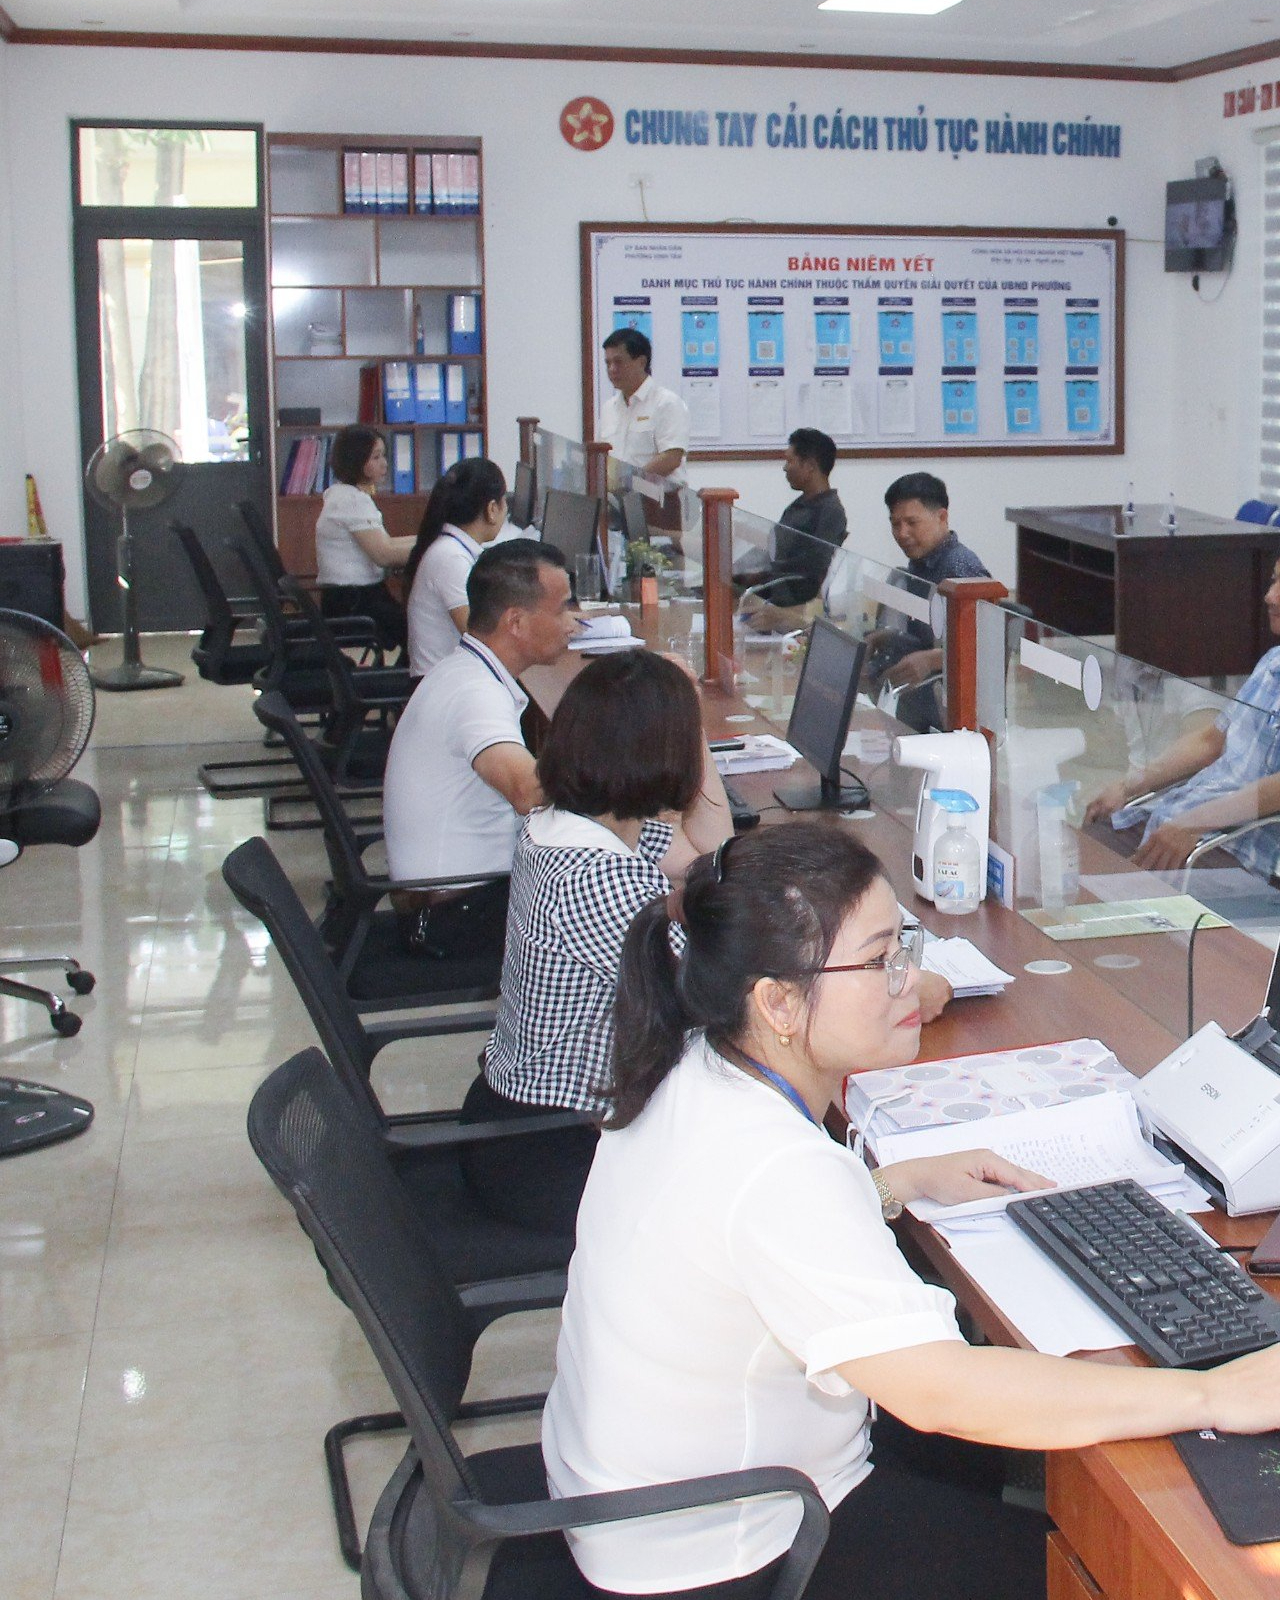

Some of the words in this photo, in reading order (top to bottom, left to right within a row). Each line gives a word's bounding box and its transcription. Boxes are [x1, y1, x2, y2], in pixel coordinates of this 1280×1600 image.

[625, 109, 709, 145] CHUNG
[715, 111, 757, 147] TAY
[766, 101, 807, 149] CẢI
[813, 108, 878, 150] CÁCH
[884, 104, 928, 151] THỦ
[935, 118, 978, 160] TỤC
[986, 112, 1048, 155] HÀNH
[1053, 115, 1121, 158] CHÍNH
[787, 252, 840, 271] BẢNG
[847, 255, 895, 272] NIÊM
[902, 253, 935, 272] YẾT
[641, 279, 671, 289] DANH
[674, 279, 698, 291] MỤC
[702, 275, 722, 289] THỦ
[725, 279, 744, 291] TỤC
[748, 276, 777, 289] HÀNH
[780, 275, 812, 289] CHÍNH
[816, 276, 850, 290] THUỘC
[852, 277, 881, 290] THẨM
[978, 277, 998, 290] CỦA
[1001, 280, 1028, 291] UBND
[1031, 278, 1072, 291] PHƯỜNG
[1200, 1082, 1221, 1101] EPSON
